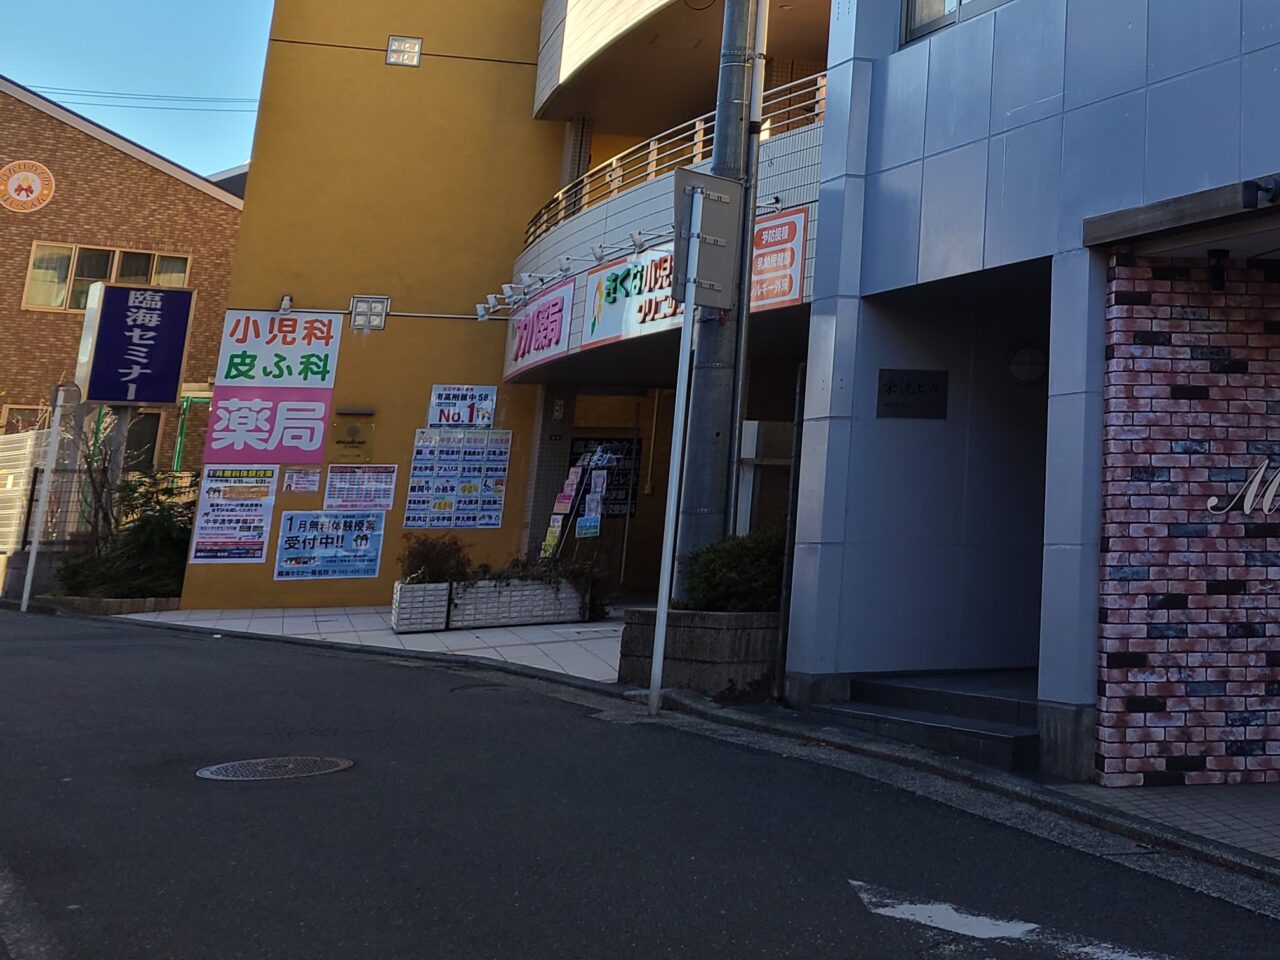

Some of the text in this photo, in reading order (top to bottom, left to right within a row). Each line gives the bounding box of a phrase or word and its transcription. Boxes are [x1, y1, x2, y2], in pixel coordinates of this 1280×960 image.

[604, 254, 675, 304] きくな小児
[636, 294, 685, 325] クリニッ
[117, 289, 164, 401] 臨海セミナー
[229, 315, 334, 348] 小児科
[224, 350, 330, 382] 皮ふ科
[211, 398, 326, 452] 薬局
[438, 402, 476, 423] No.1
[286, 516, 376, 532] 1月無料体験授業
